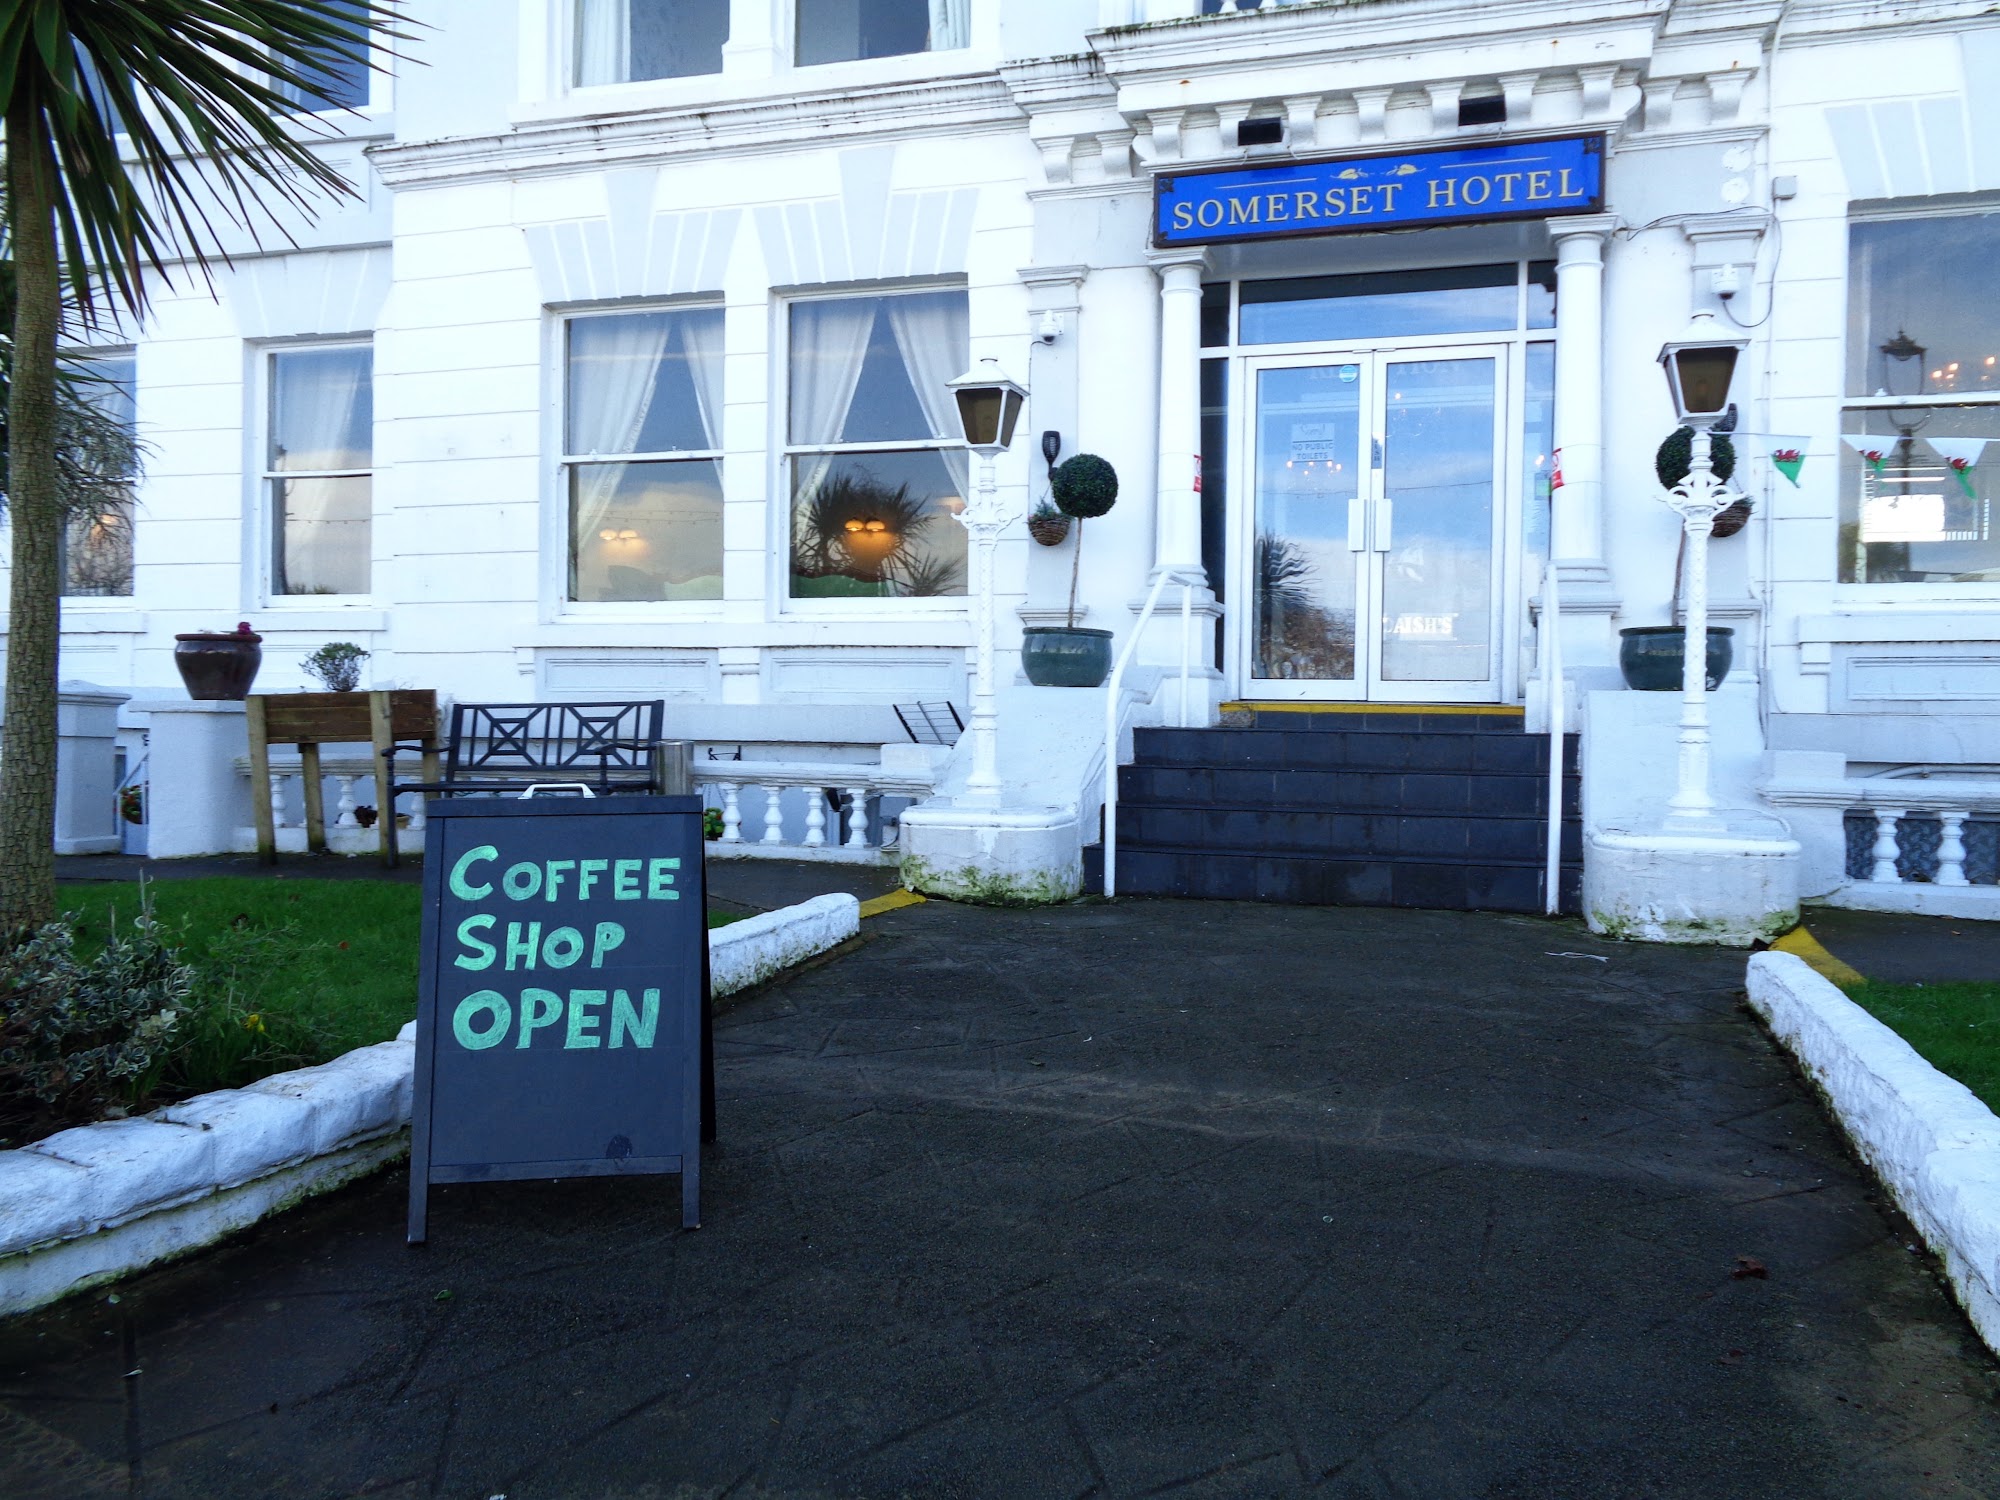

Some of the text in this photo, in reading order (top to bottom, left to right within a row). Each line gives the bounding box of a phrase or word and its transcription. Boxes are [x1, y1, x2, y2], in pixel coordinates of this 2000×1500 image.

[1173, 168, 1584, 231] SOMERSET HOTEL
[1296, 452, 1329, 460] TOILETS
[1305, 442, 1334, 451] PUBLIC
[449, 845, 681, 902] COFFEE
[454, 913, 626, 971] SHOP
[452, 987, 661, 1051] OPEN
